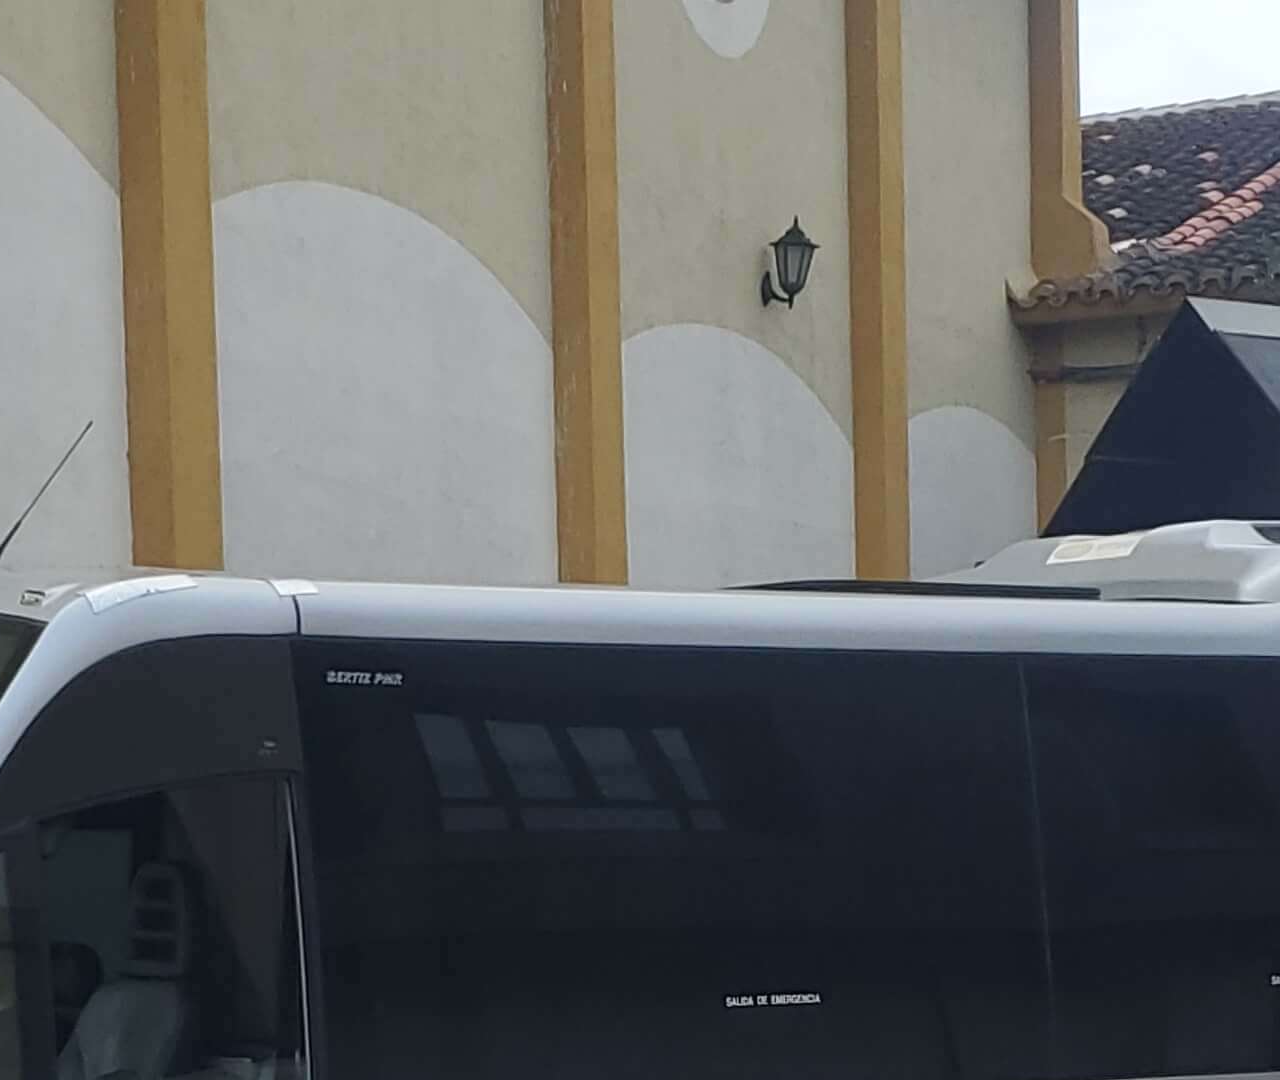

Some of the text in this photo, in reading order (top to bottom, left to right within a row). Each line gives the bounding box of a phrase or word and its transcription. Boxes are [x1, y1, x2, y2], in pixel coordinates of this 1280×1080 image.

[726, 992, 821, 1007] SALIDA DE EMERGENCIA
